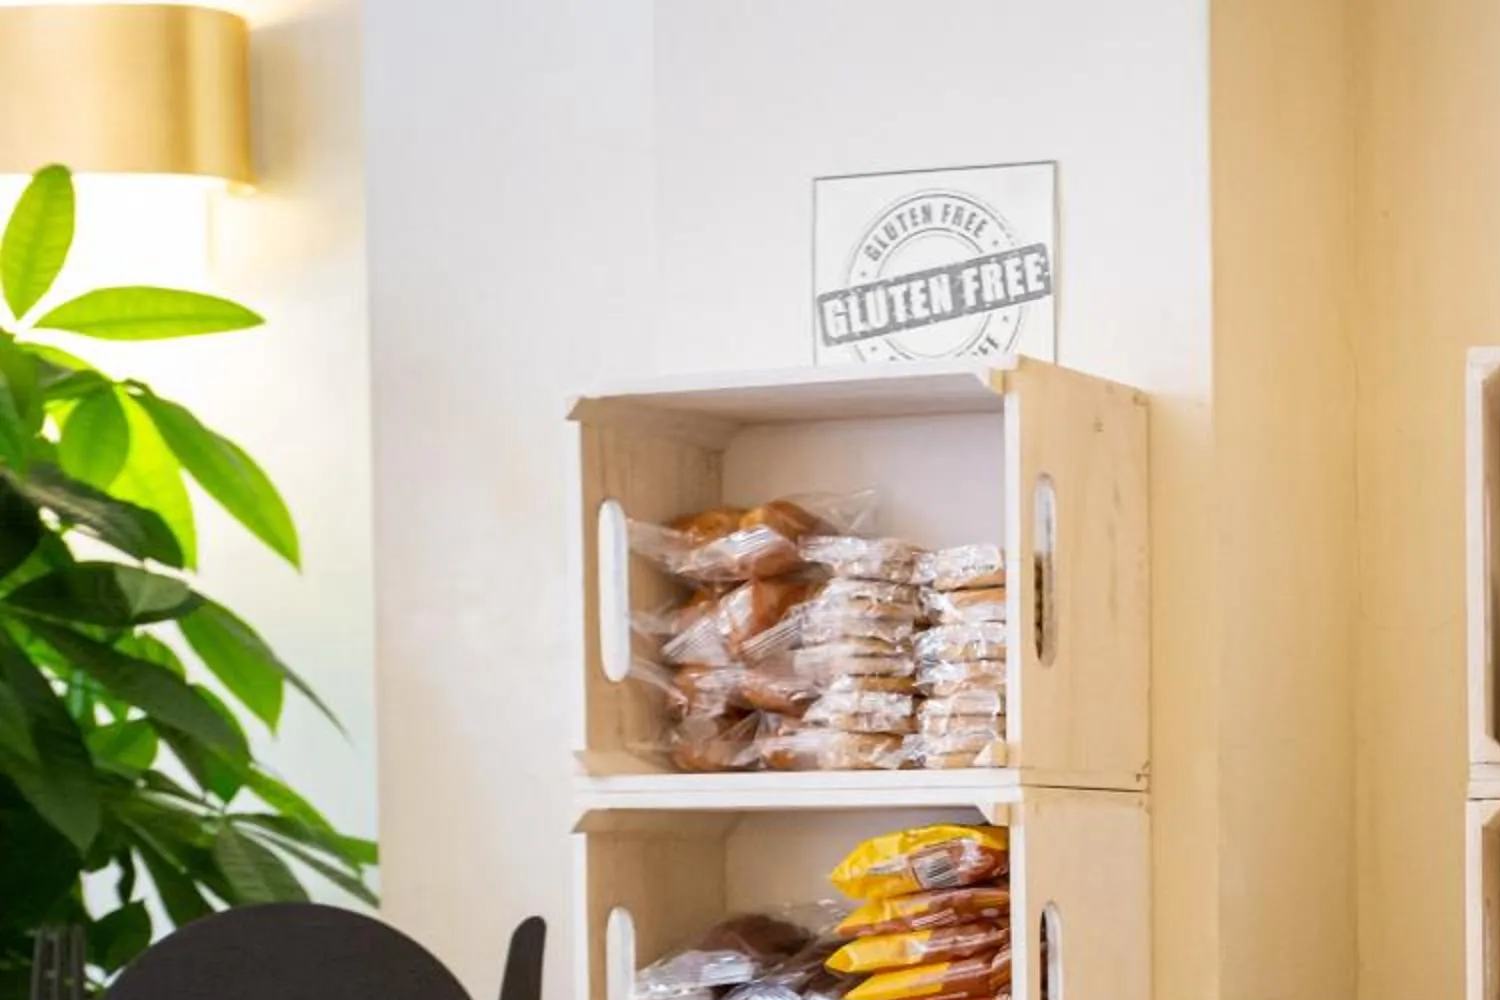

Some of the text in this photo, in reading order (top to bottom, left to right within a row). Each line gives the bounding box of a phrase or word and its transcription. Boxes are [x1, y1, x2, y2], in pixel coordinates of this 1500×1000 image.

[864, 203, 989, 262] GLUTEN FREE
[821, 252, 1046, 340] GLUTEN FREE
